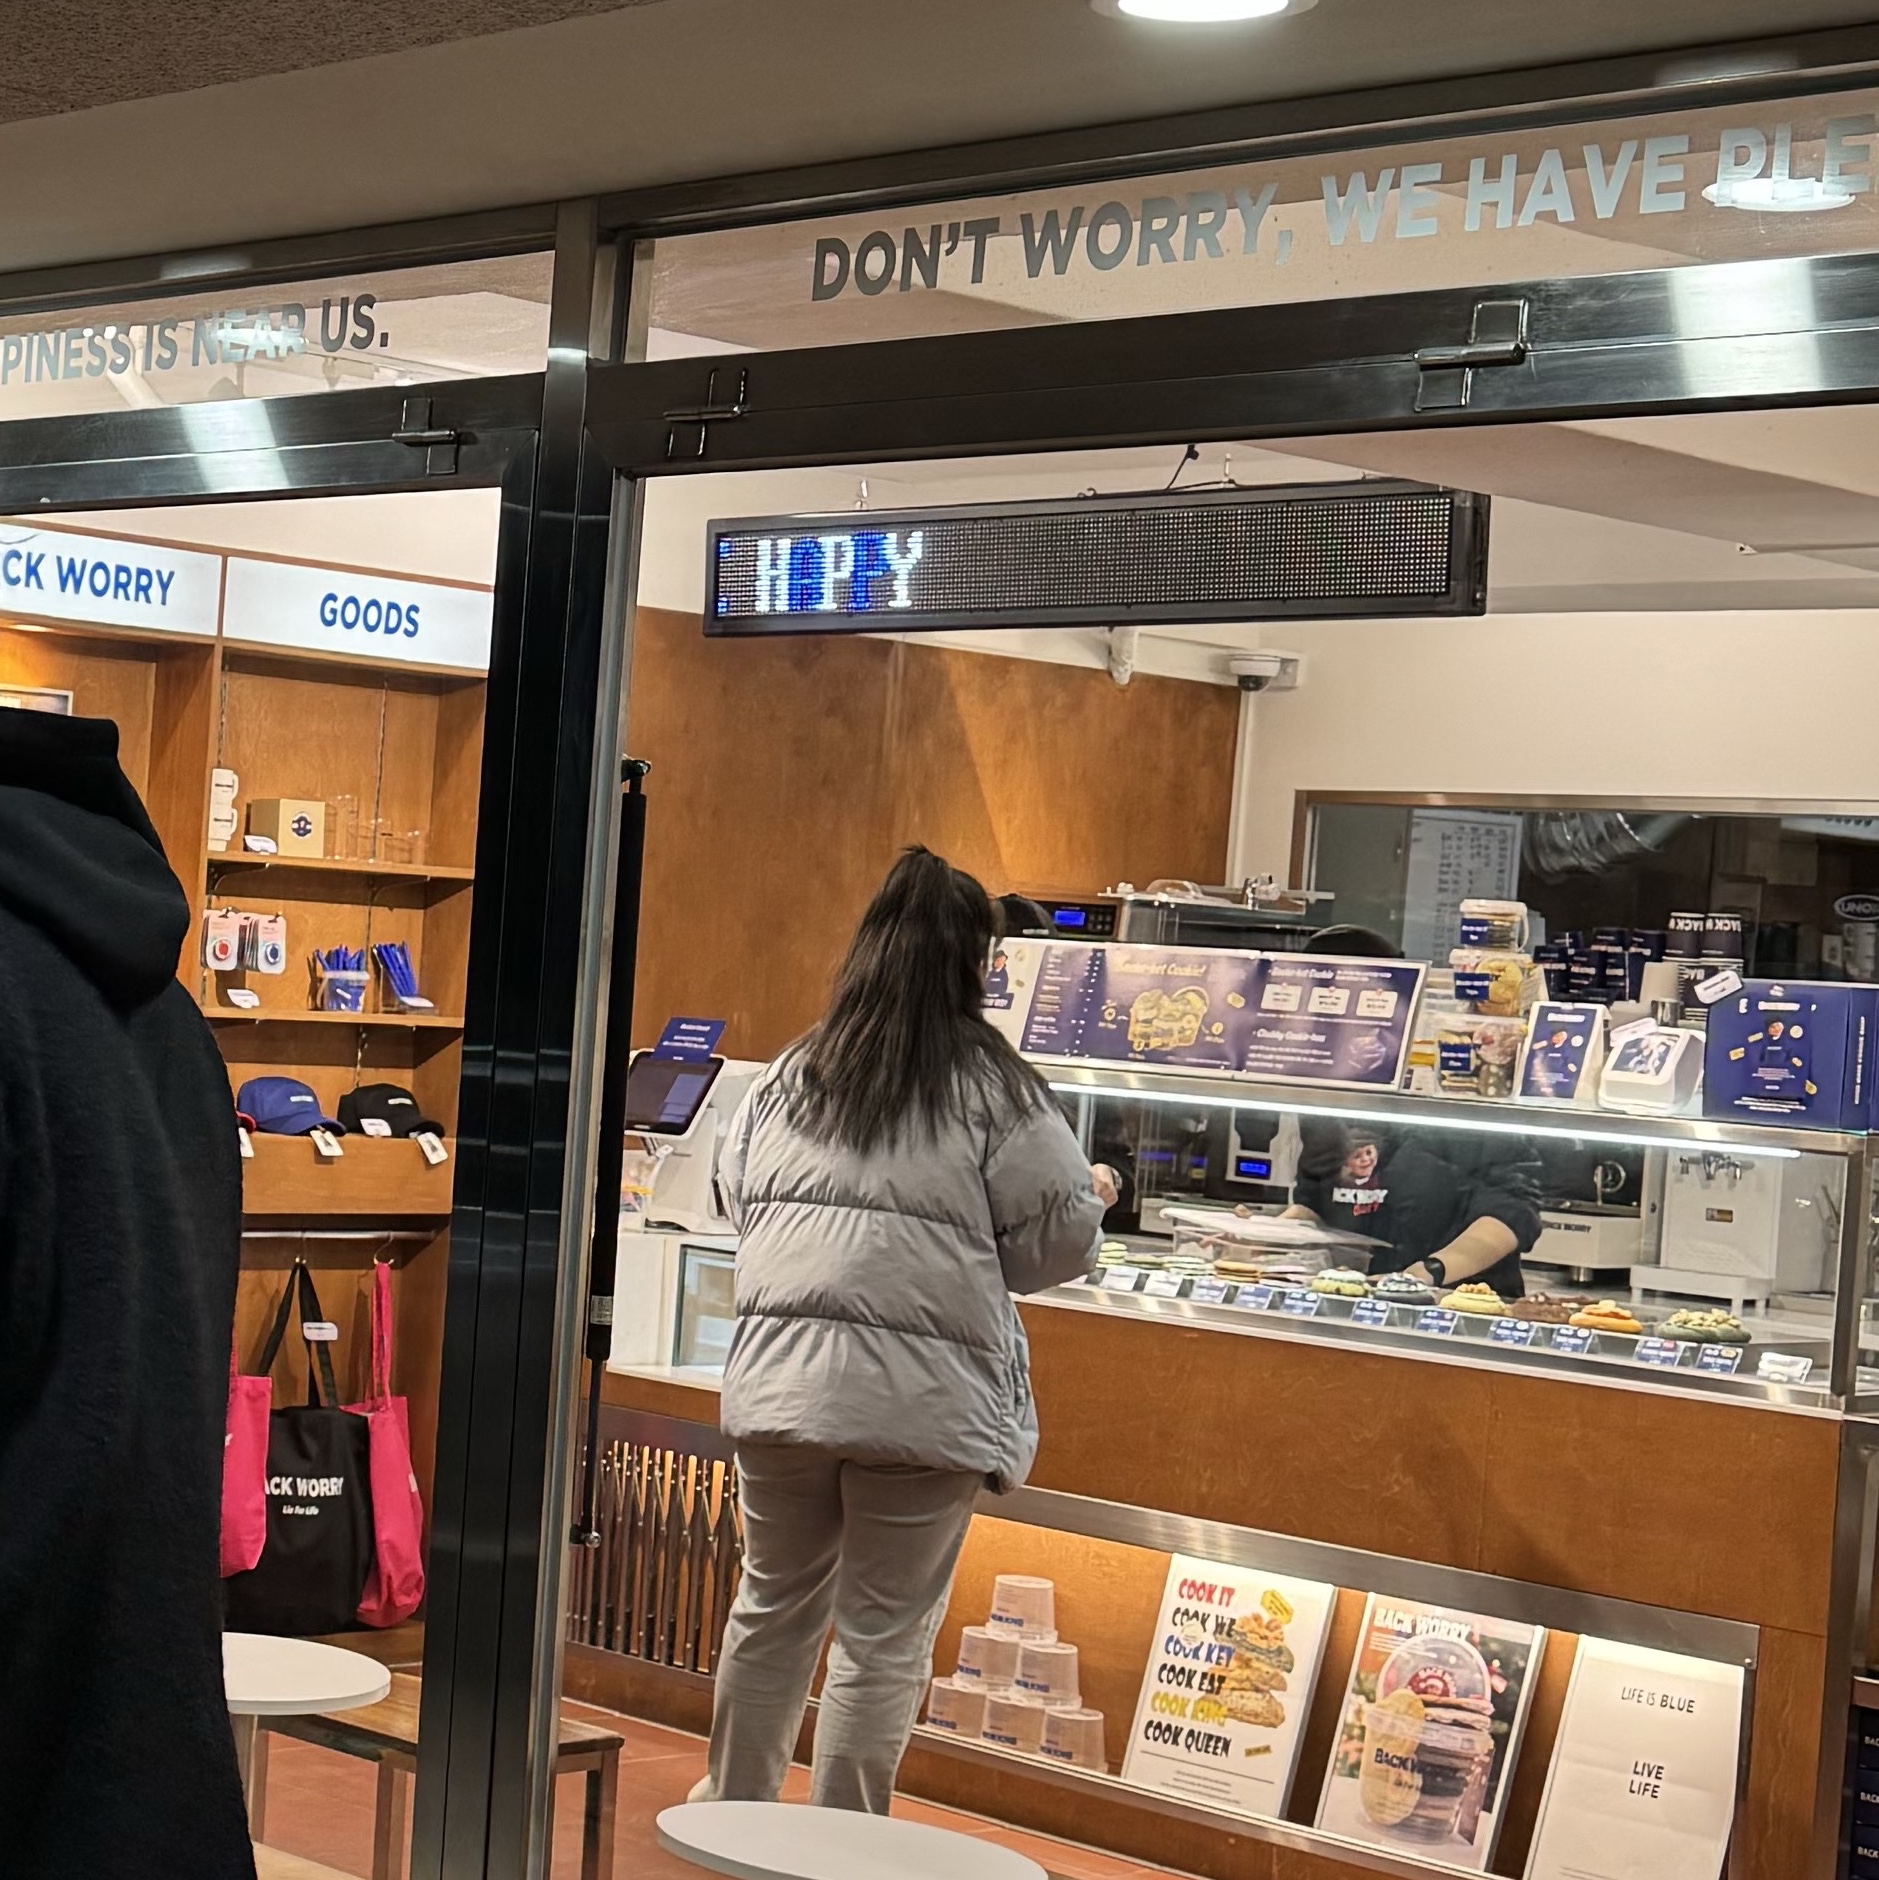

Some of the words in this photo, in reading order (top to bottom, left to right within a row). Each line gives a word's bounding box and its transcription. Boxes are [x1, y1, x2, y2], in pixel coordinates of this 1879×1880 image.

[811, 216, 1001, 302] DON'T
[1020, 182, 1293, 280] WORRY,
[1321, 163, 1443, 246] WE
[1464, 134, 1690, 233] HAVE
[144, 317, 179, 372] IS
[191, 302, 307, 368] NEAR
[321, 293, 390, 352] US.
[56, 555, 176, 607] WORRY
[319, 591, 421, 639] GOODS
[296, 1476, 344, 1498] WORRY
[1178, 1578, 1217, 1604] COOK
[1218, 1586, 1236, 1608] IT
[1373, 1608, 1413, 1635] BACK
[1157, 1662, 1196, 1688] COOK
[1150, 1691, 1190, 1718] COOK
[1621, 1686, 1644, 1704] LIFE
[1647, 1691, 1656, 1706] IS
[1660, 1694, 1696, 1713] BLUE
[1143, 1719, 1184, 1747] COOK
[1184, 1727, 1232, 1759] QUEEN
[1633, 1760, 1665, 1781] LIVE
[1629, 1779, 1660, 1799] LIFE
